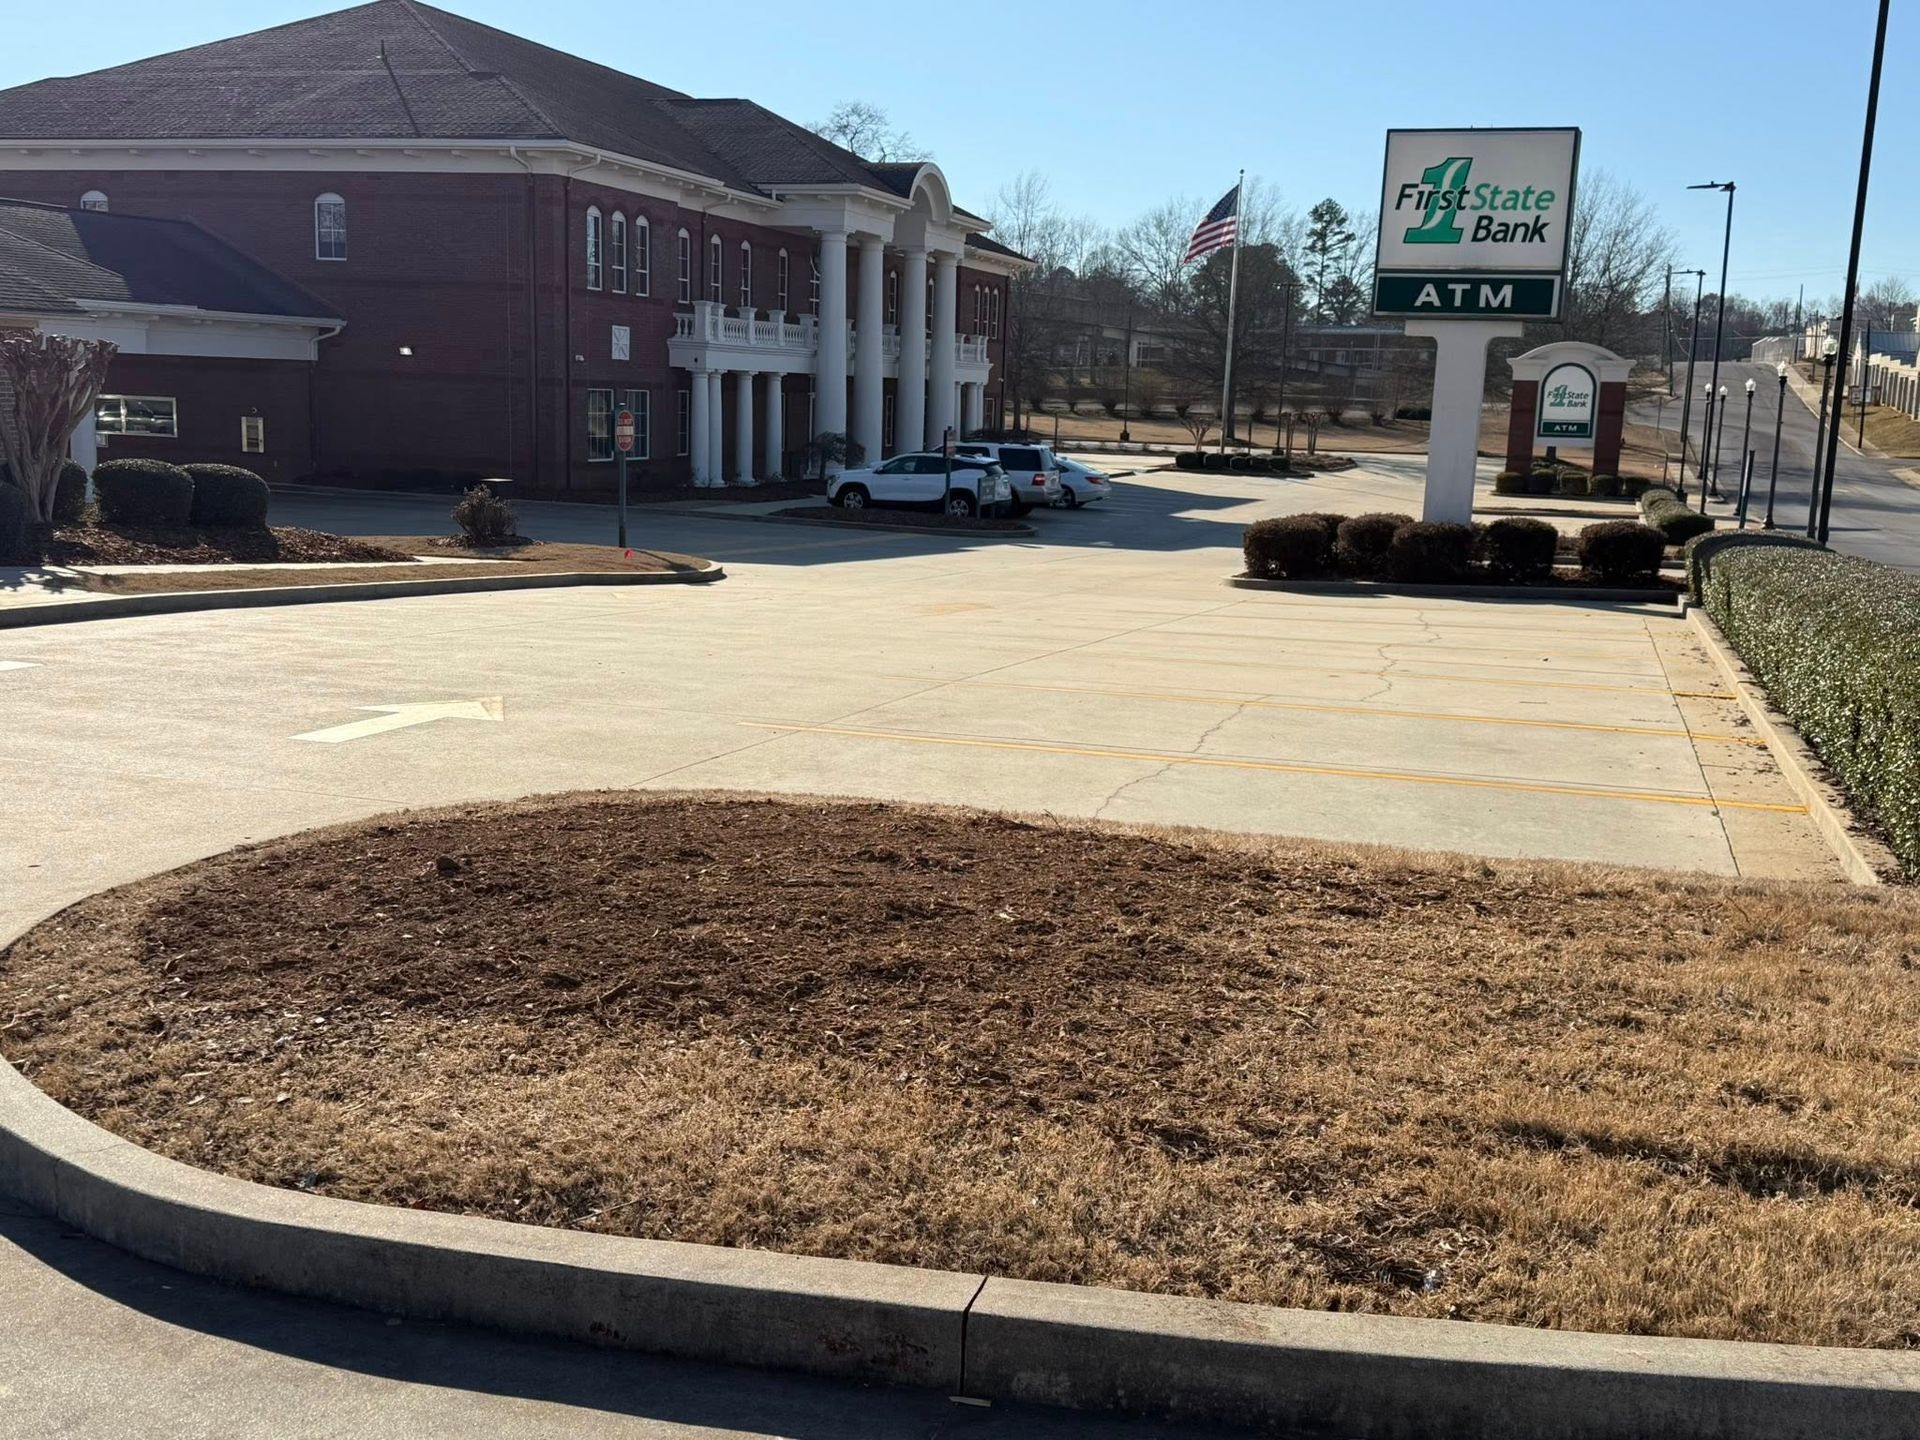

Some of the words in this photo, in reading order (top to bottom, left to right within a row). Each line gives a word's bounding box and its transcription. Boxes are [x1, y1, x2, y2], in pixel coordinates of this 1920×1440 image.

[1395, 183, 1470, 211] First
[1470, 183, 1556, 211] State
[1471, 214, 1551, 243] Bank
[1414, 283, 1513, 308] ATM
[1567, 391, 1589, 400] State
[1567, 400, 1587, 408] Bank
[1554, 424, 1577, 432] ATM
